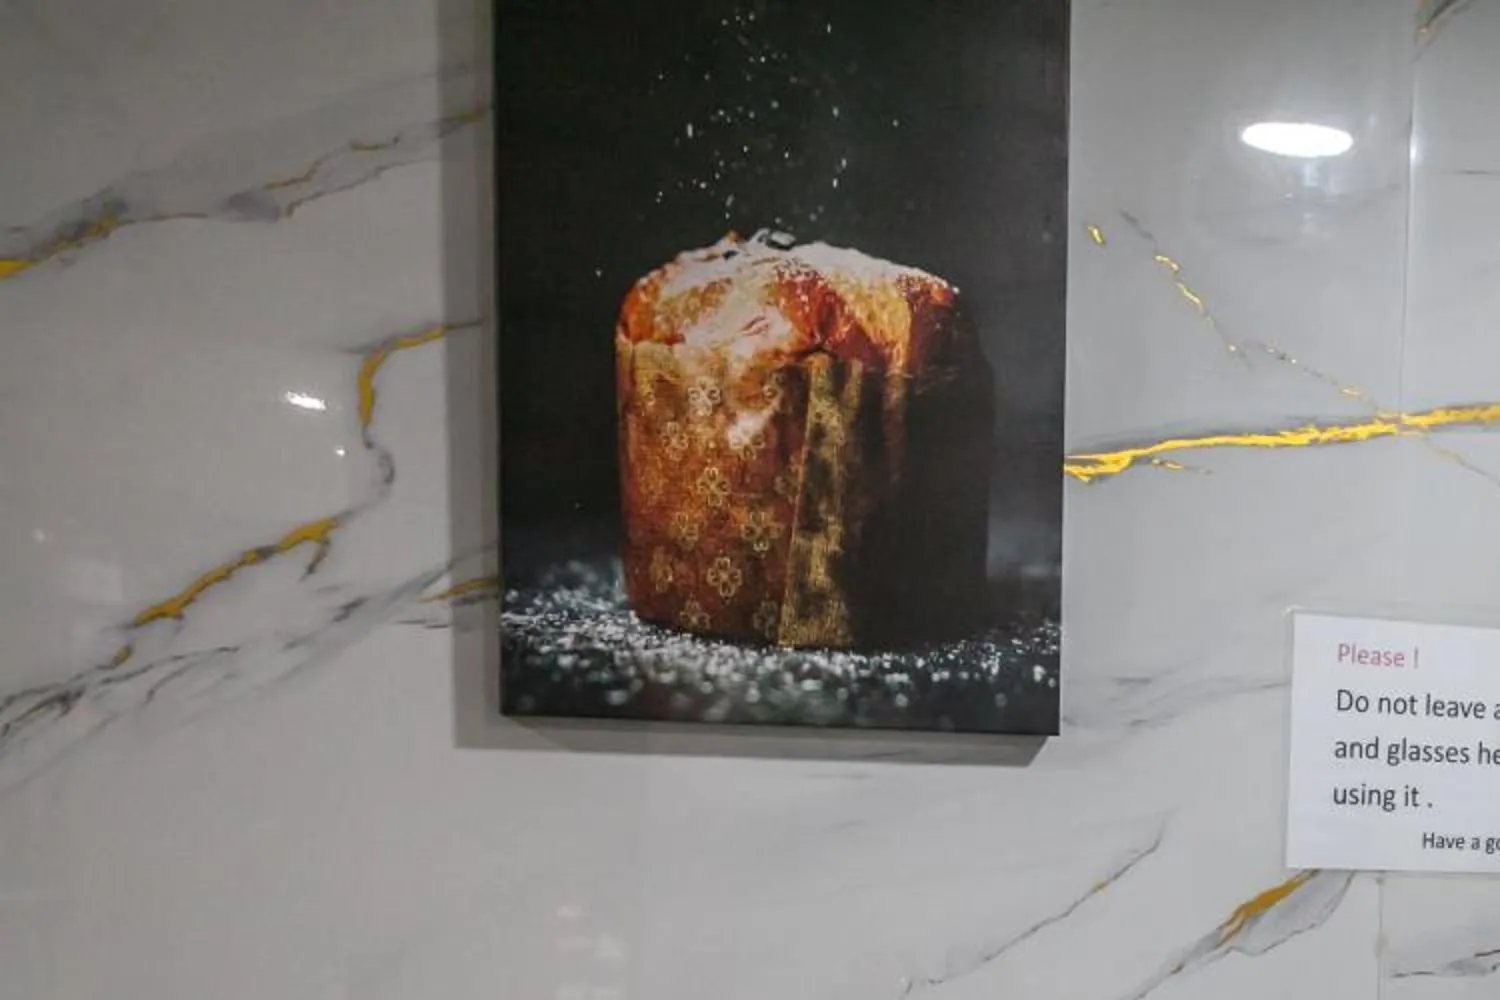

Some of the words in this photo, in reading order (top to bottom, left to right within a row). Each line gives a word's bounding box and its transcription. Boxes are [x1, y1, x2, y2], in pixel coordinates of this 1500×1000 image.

[1338, 643, 1405, 668] Please
[1337, 688, 1369, 713] Do
[1378, 694, 1419, 715] not
[1425, 693, 1487, 720] leave
[1334, 736, 1379, 760] and
[1387, 736, 1470, 766] glasses
[1333, 783, 1396, 812] using
[1403, 784, 1420, 807] it
[1422, 831, 1465, 850] Have
[1471, 837, 1481, 850] a
